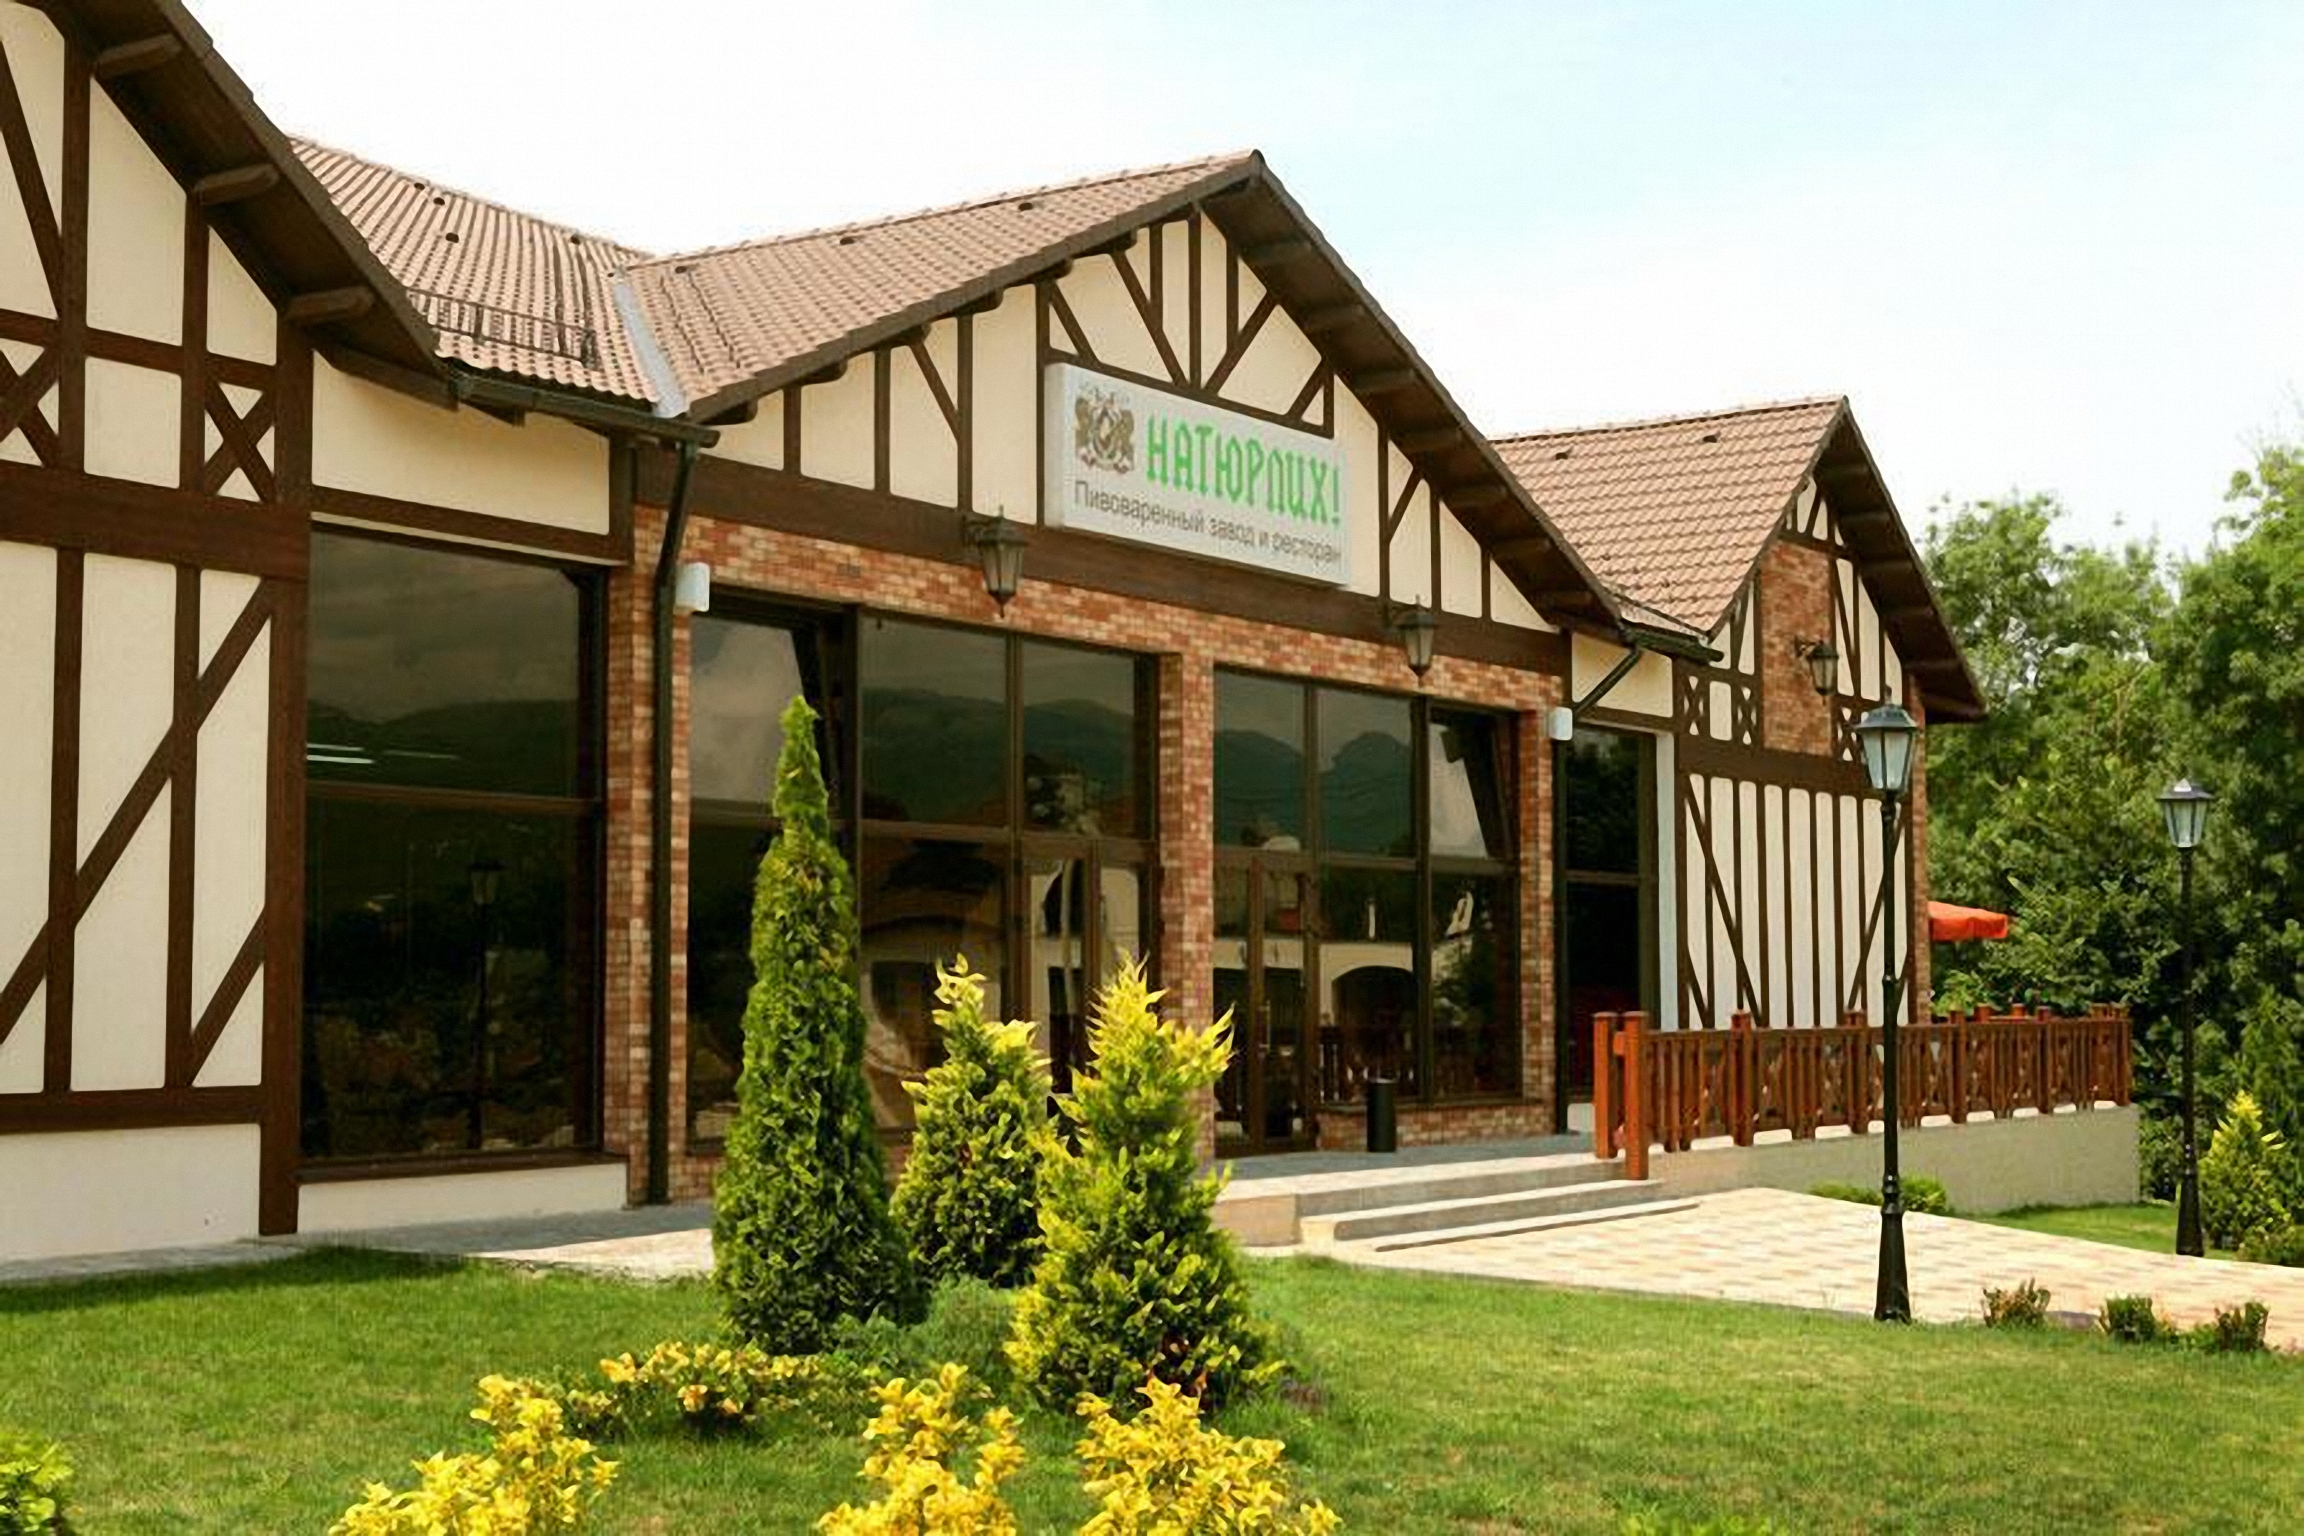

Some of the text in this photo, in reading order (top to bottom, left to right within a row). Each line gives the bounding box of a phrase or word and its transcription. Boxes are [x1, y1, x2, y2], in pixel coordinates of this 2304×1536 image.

[1075, 480, 1204, 532] Пивоваренный
[1210, 517, 1255, 548] завод
[1259, 530, 1269, 547] и
